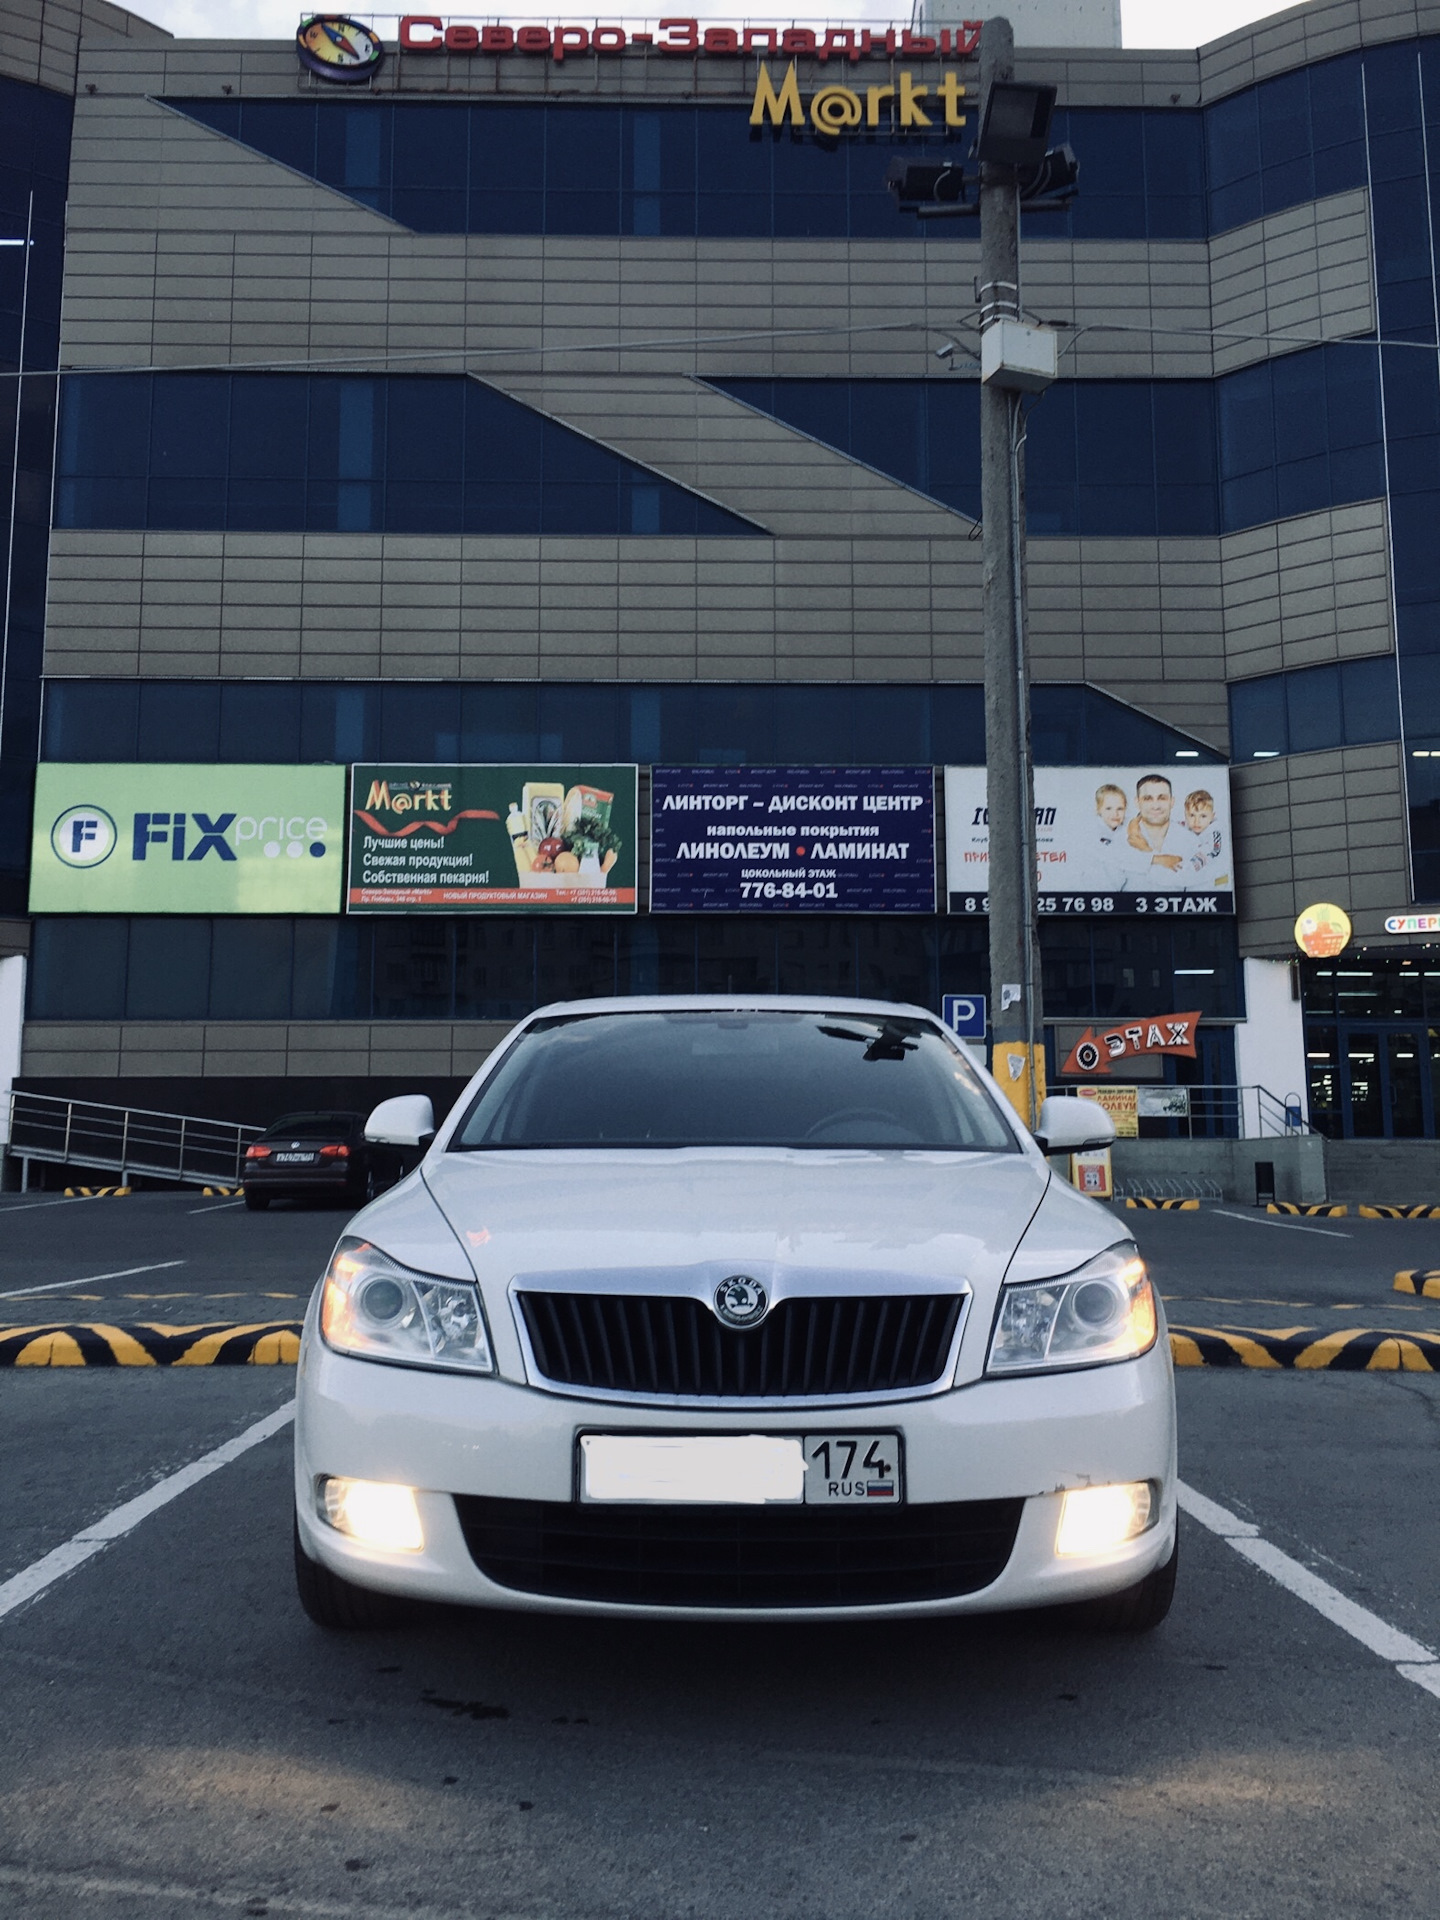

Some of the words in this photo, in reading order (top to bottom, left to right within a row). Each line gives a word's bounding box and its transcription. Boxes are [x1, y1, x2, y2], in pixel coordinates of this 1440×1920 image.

[400, 16, 983, 61] Северо-Западный
[749, 59, 967, 135] M@rkt
[662, 795, 748, 811] ЛИНТОРГ
[768, 795, 858, 813] ДИСКОНТ
[862, 796, 923, 813] ЦЕНТР
[235, 816, 328, 846] price
[706, 826, 797, 837] напольные
[800, 826, 880, 839] покрытия
[362, 836, 408, 852] Лучшие
[410, 836, 445, 851] цены!
[676, 842, 790, 860] ЛИНОЛЕУМ
[810, 842, 910, 860] ЛАМИНАТ
[362, 853, 406, 866] Свежая
[408, 853, 474, 869] продукция!
[362, 870, 438, 884] Собственная
[439, 870, 490, 886] пекарня!
[741, 867, 806, 879] ЦОКОЛЬНЫЙ
[807, 869, 837, 879] ЭТАЖ
[443, 891, 467, 899] НОВЫЙ
[468, 891, 516, 900] ПРОДУКТОВЫЙ
[517, 891, 548, 900] МАГАЗИН
[739, 882, 839, 900] 776-84-01
[964, 897, 977, 912] 8
[1062, 897, 1086, 912] 76
[1090, 897, 1115, 912] 98
[1135, 897, 1149, 913] 3
[1154, 897, 1218, 913] ЭТАЖ
[1387, 917, 1440, 930] СУПЕР
[1103, 1021, 1191, 1058] ЭТАЖ
[1099, 1102, 1137, 1111] ОЛЕУМ
[810, 1440, 885, 1480] 174
[827, 1481, 865, 1497] RUS
